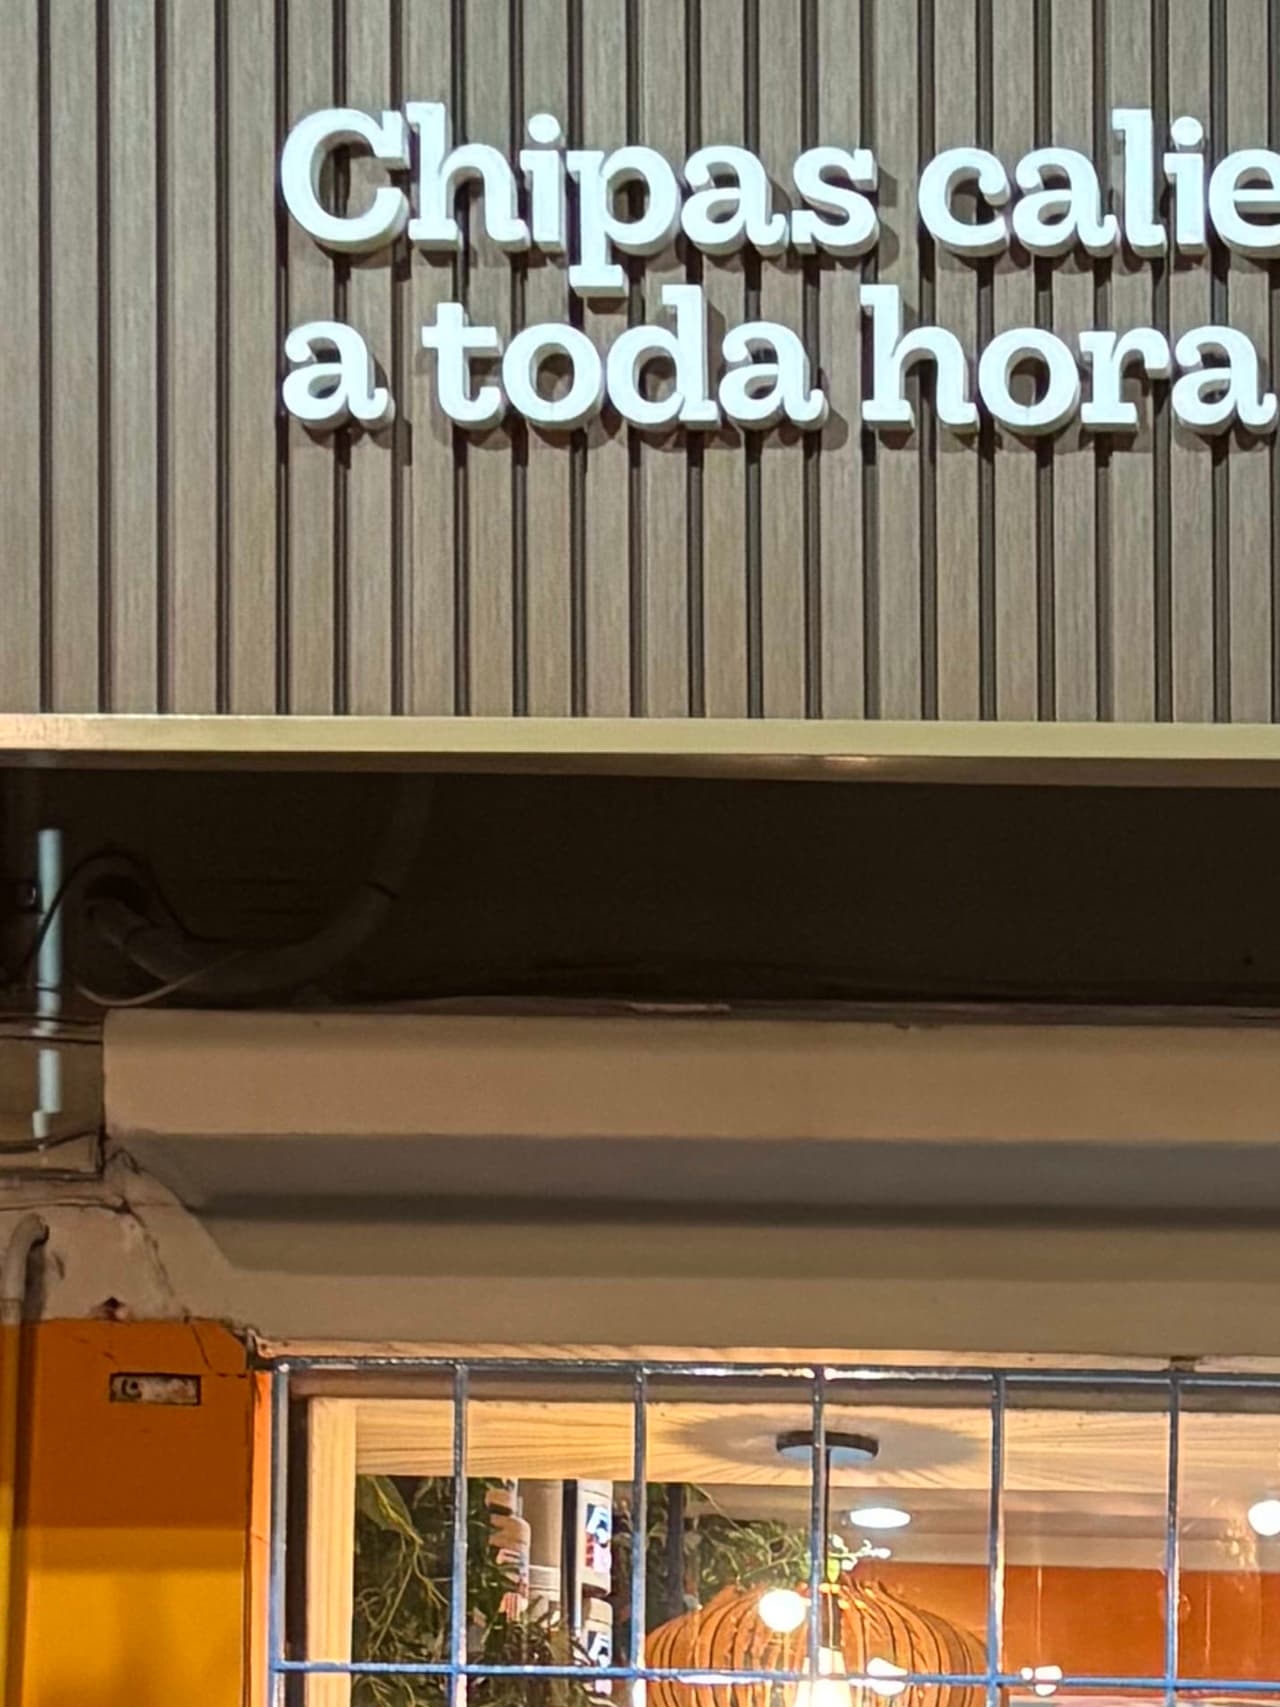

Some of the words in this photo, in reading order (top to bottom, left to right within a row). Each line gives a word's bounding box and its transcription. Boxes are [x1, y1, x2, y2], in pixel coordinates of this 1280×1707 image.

[280, 100, 880, 294] Chipas
[281, 316, 389, 431] a
[422, 284, 826, 431] toda
[860, 282, 1279, 433] hora
